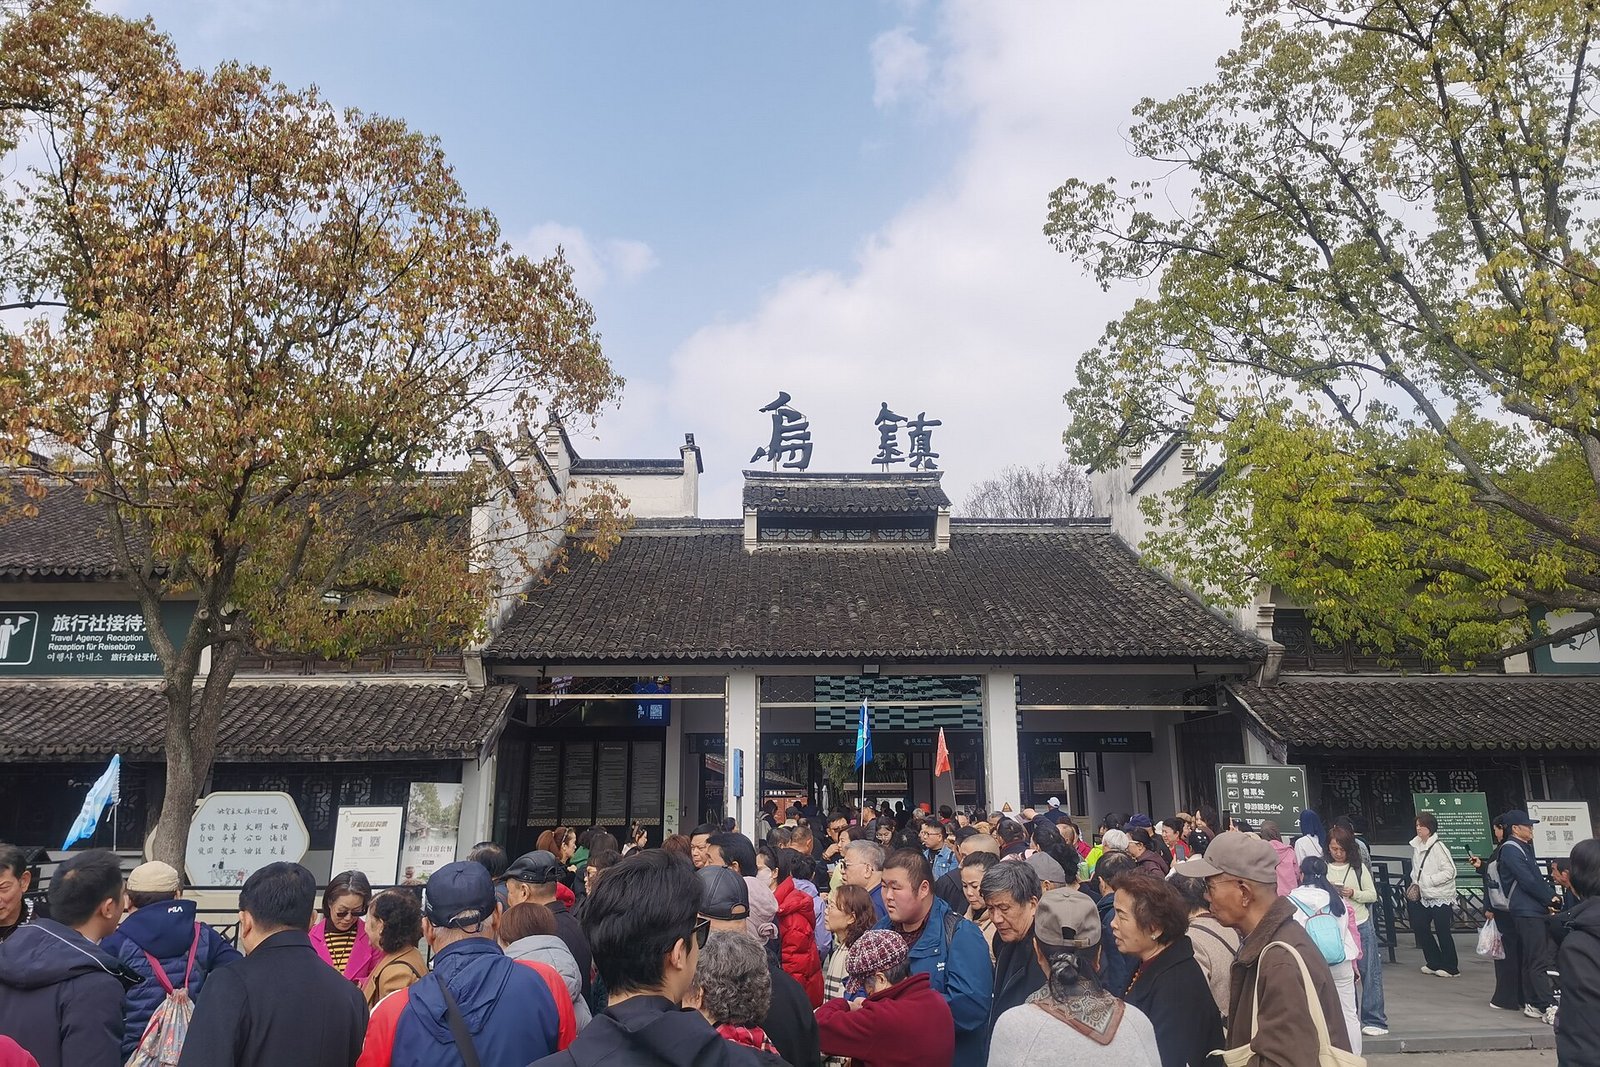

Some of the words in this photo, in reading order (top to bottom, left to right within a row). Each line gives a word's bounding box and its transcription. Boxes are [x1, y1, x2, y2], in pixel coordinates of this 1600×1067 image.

[51, 614, 147, 632] 旅行社接待
[75, 634, 104, 643] Agency
[106, 634, 144, 643] Reception
[48, 643, 85, 652] Rezeption
[86, 643, 97, 651] für
[98, 643, 136, 651] Reisebüro
[76, 652, 103, 662] 안내소
[110, 652, 160, 662] 旅行会社受付
[1241, 772, 1269, 780] 行李服务
[1243, 787, 1265, 795] 售票处
[1244, 802, 1284, 811] 导游服务中心
